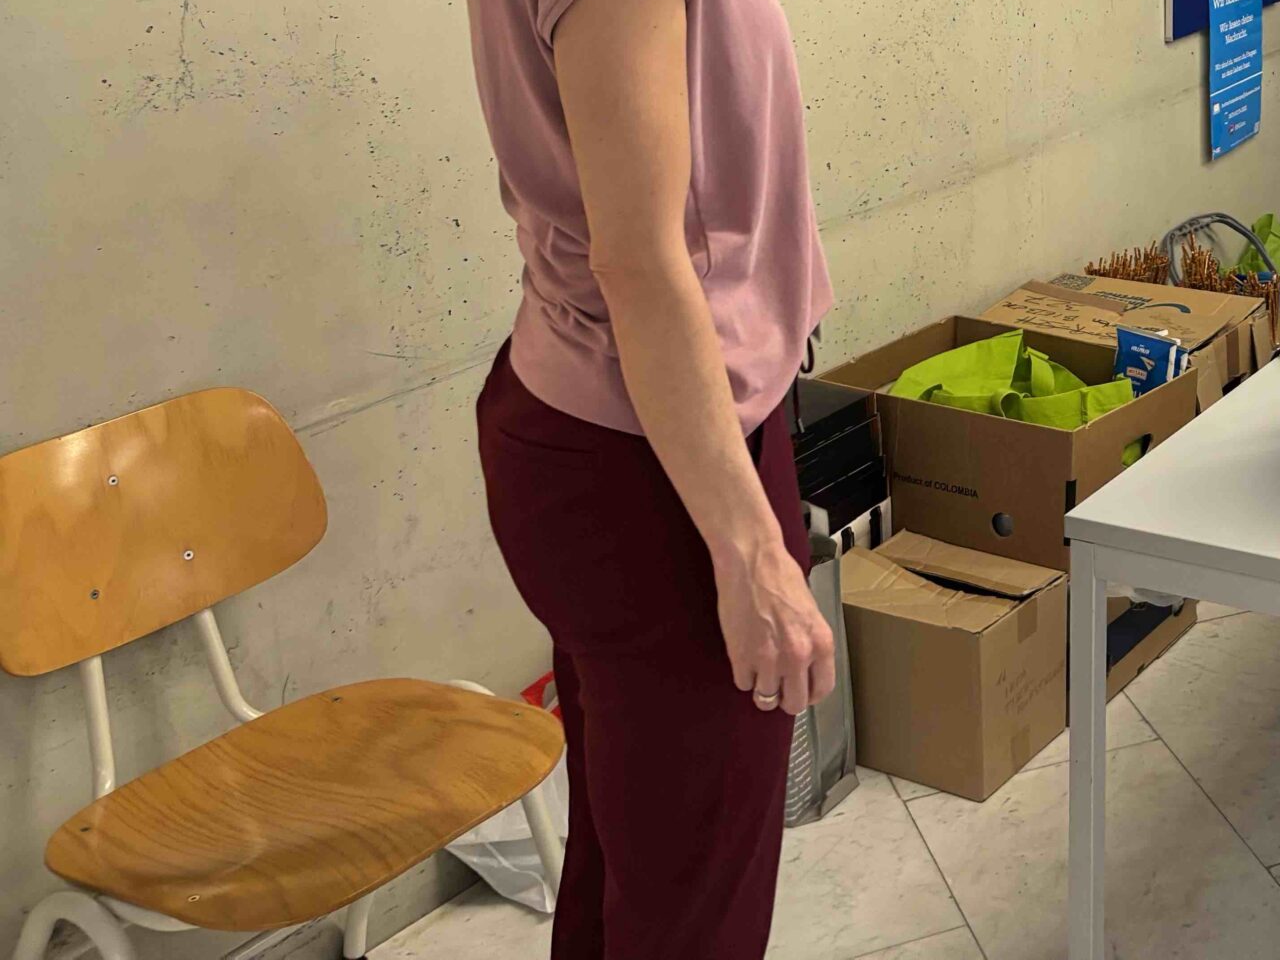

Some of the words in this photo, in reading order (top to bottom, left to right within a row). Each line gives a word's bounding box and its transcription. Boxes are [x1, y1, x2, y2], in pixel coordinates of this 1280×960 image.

[893, 471, 923, 485] Product
[924, 479, 932, 488] of
[934, 481, 979, 498] COLOMBIA
